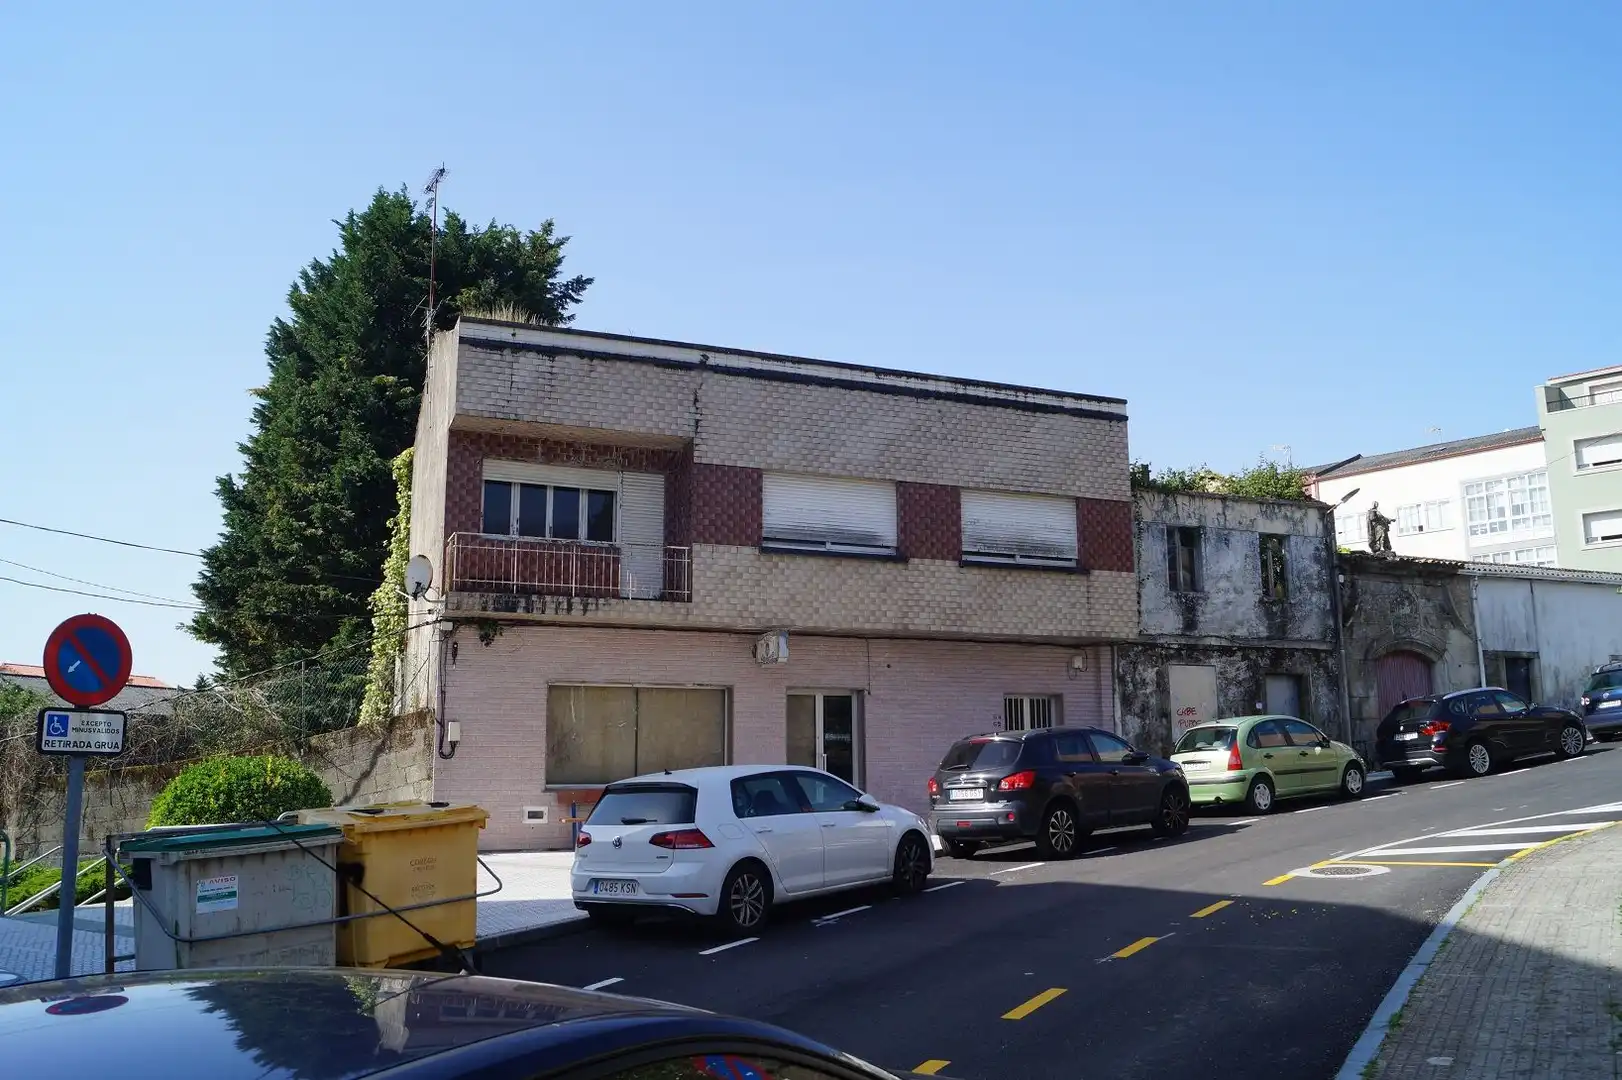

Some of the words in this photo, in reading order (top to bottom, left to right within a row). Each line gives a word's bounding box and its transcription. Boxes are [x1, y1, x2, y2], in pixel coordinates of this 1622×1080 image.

[71, 726, 120, 734] MINUSVALIDOS
[43, 739, 92, 749] RETIRADA
[94, 740, 120, 750] GRUA
[209, 876, 236, 885] AVISO
[599, 881, 619, 893] 0485
[620, 881, 637, 894] KSN
